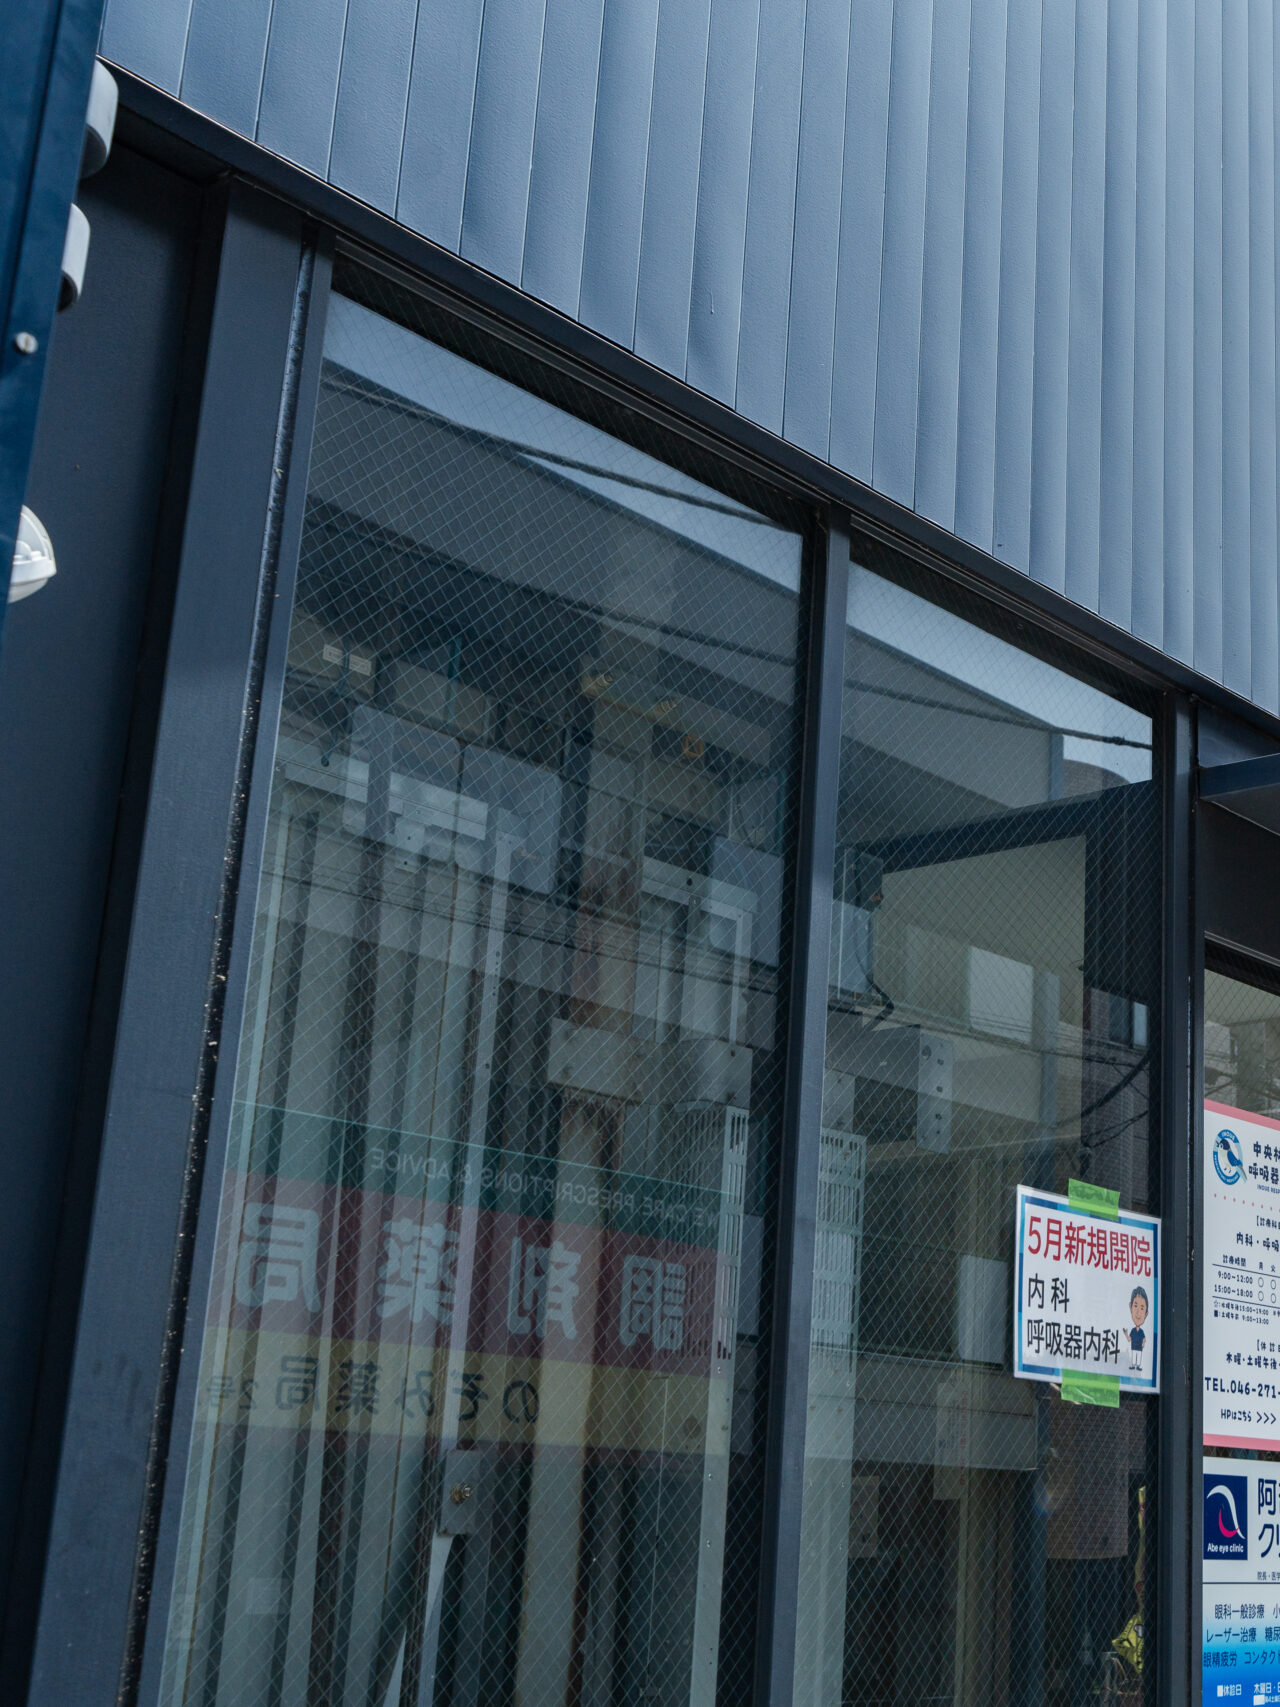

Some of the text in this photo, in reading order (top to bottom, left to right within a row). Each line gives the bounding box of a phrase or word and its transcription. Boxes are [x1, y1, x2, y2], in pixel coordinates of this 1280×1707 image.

[1028, 1216, 1151, 1277] 5月新規開院
[1027, 1319, 1120, 1364] 呼吸器内科
[1221, 1408, 1252, 1423] HPはこちら
[1207, 1543, 1244, 1554] Abe eye clinic
[1215, 1604, 1264, 1619] 眼科一般診療
[1207, 1626, 1256, 1643] レーザー治療
[1203, 1651, 1237, 1668] 眼精疲労
